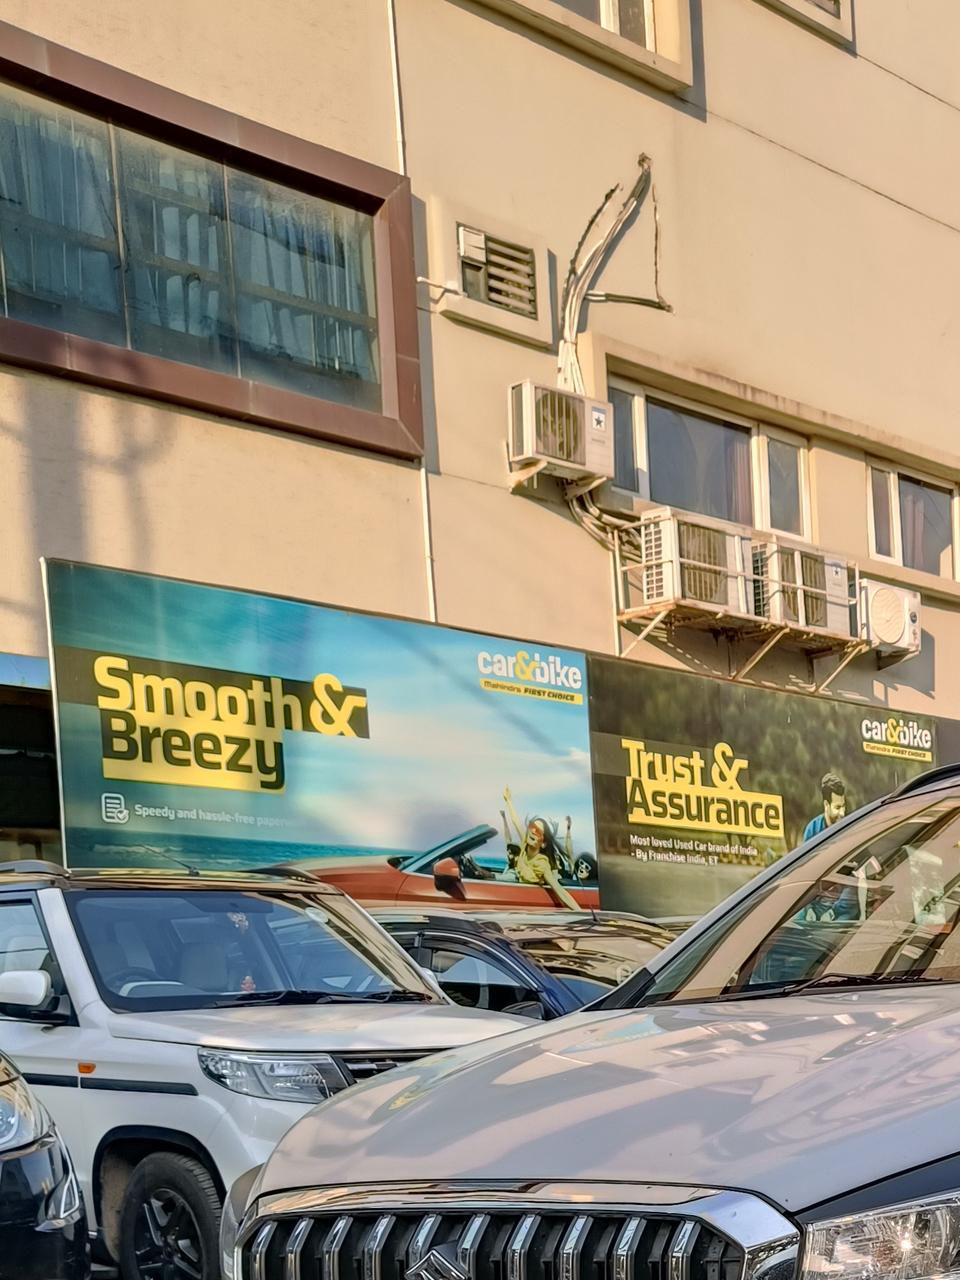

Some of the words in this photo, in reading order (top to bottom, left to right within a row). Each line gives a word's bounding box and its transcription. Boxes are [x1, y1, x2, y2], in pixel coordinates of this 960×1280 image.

[477, 650, 582, 689] car&bike
[94, 655, 303, 731] Smooth
[309, 673, 367, 737] &
[523, 687, 547, 698] FIRST
[547, 691, 575, 702] CHOICE
[100, 710, 285, 790] Breezy
[861, 718, 932, 749] car&bike
[621, 738, 705, 787] Trust
[711, 742, 749, 791] &
[134, 803, 175, 820] Speedy
[176, 808, 197, 820] and
[199, 809, 255, 825] hassle-free
[627, 778, 780, 831] Assurance
[630, 834, 651, 846] Most
[651, 836, 673, 849] loved
[674, 839, 693, 851] Used
[694, 840, 708, 851] Car
[708, 843, 730, 854] brand
[730, 845, 739, 854] of
[739, 846, 758, 856] India
[636, 849, 648, 862] By
[648, 850, 686, 864] Franchise
[708, 855, 719, 865] ET
